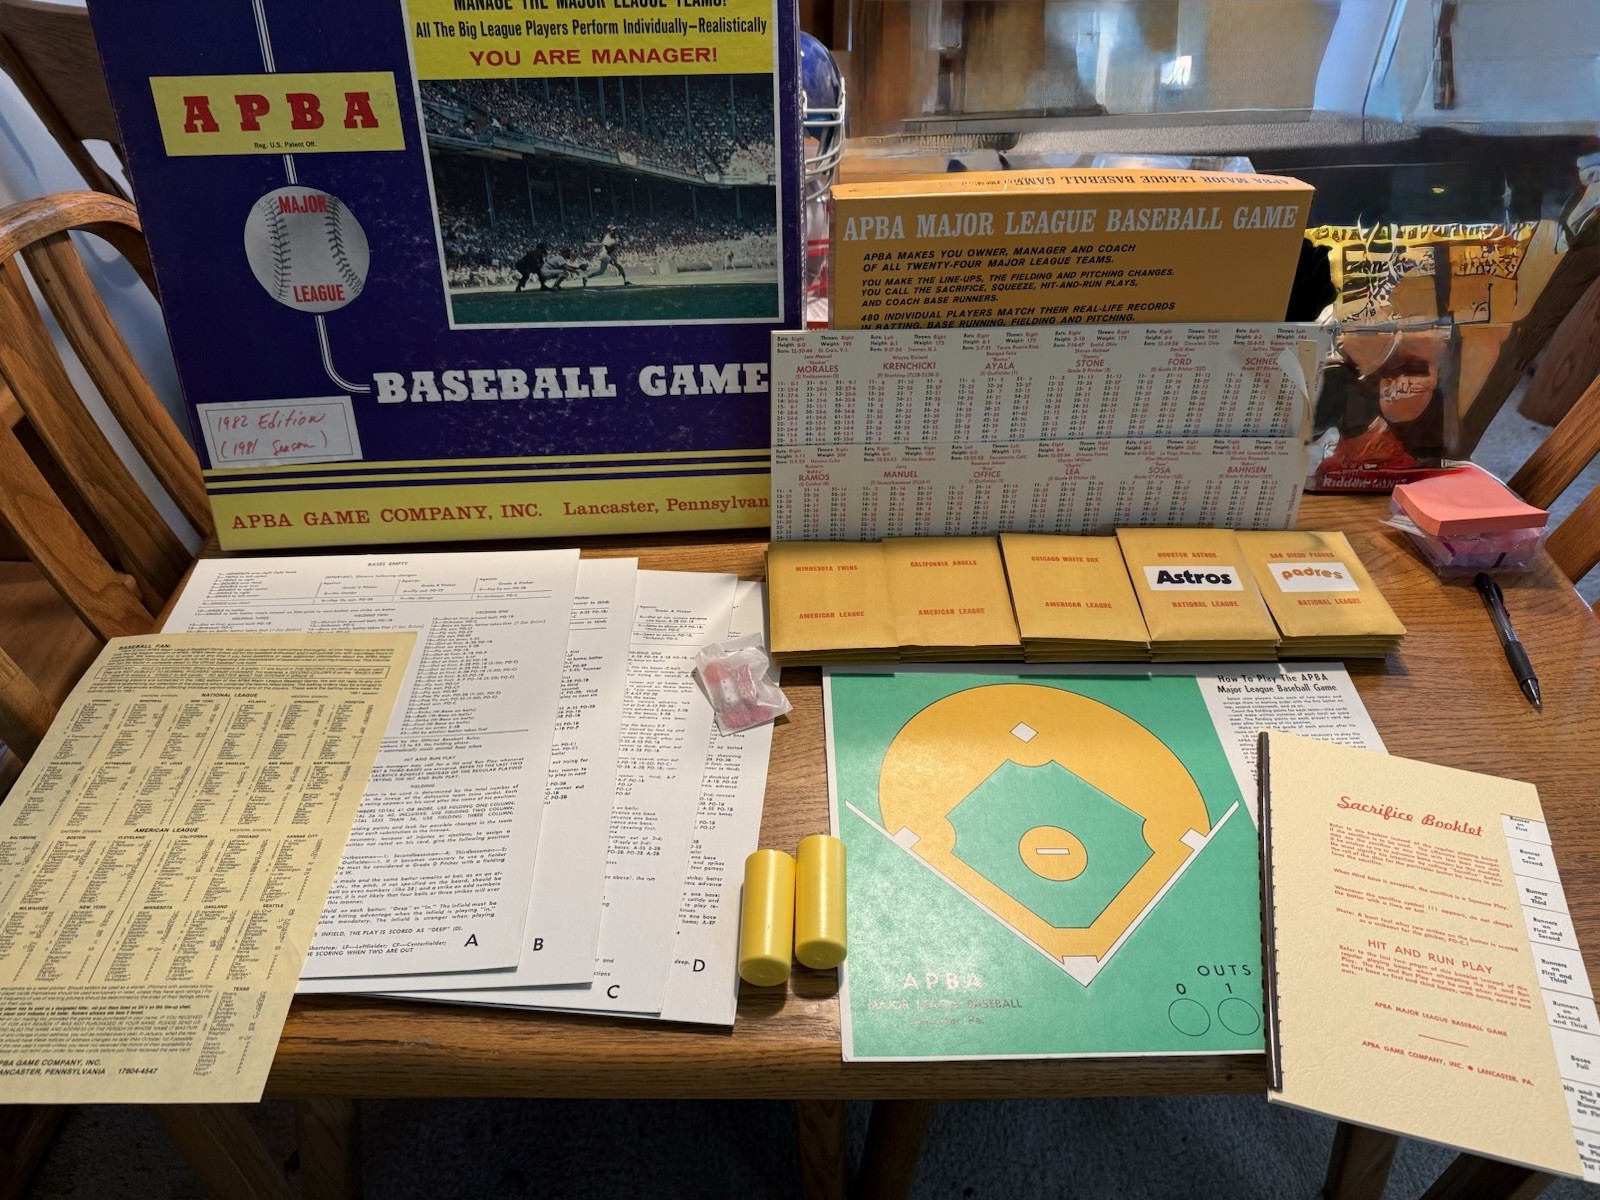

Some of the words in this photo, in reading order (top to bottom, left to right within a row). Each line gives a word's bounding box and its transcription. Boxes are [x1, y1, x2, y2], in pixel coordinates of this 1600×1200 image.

[416, 22, 431, 38] All
[434, 21, 456, 38] The
[458, 20, 478, 40] Big
[480, 20, 522, 39] League
[525, 19, 568, 38] Players
[572, 19, 618, 36] Perform
[469, 50, 520, 66] YOU
[532, 50, 581, 64] ARE
[592, 48, 718, 64] MANAGER!
[183, 92, 379, 133] APBA
[278, 195, 328, 214] MAJOR
[843, 216, 905, 241] APBA
[916, 212, 994, 238] MAJOR
[1004, 209, 1096, 235] LEAGUE
[1106, 207, 1223, 232] BASEBALL
[1233, 205, 1298, 229] GAME
[863, 252, 892, 261] APBA
[898, 250, 935, 259] MAKES
[941, 250, 962, 258] YOU
[967, 248, 1008, 258] OWNER,
[1013, 246, 1066, 255] MANAGER
[1071, 245, 1093, 254] AND
[1098, 244, 1136, 252] COACH
[863, 264, 878, 272] OF
[882, 262, 900, 271] ALL
[907, 260, 982, 270] TWENTY-FOUR
[988, 258, 1025, 268] MAJOR
[1030, 257, 1070, 266] LEAGUE
[1076, 256, 1113, 264] TEAMS.
[862, 278, 881, 287] YOU
[885, 277, 913, 286] MAKE
[918, 277, 935, 285] THE
[939, 275, 984, 284] LINE-UPS,
[1011, 272, 1052, 281] FIELDING
[1080, 270, 1123, 278] PITCHING
[1128, 268, 1174, 276] CHANGES.
[293, 284, 346, 302] LEAGUE
[862, 288, 881, 296] YOU
[885, 287, 909, 295] CALL
[936, 284, 987, 294] SACRIFICE,
[991, 283, 1036, 292] SQUEEZE,
[1040, 281, 1101, 289] HIT-AND-RUN
[1106, 279, 1138, 288] PLAYS,
[862, 299, 881, 307] AND
[953, 295, 998, 303] RUNNERS.
[861, 313, 879, 321] 480
[884, 311, 941, 320] INDIVIDUAL
[947, 309, 992, 318] PLAYERS
[1040, 306, 1068, 314] THEIR
[1073, 304, 1123, 312] REAL-LIFE
[1127, 302, 1176, 311] RECORDS
[797, 365, 838, 373] MORALES
[883, 362, 936, 370] KRENCHICKI
[1076, 359, 1104, 367] STONE
[1168, 358, 1192, 366] FORD
[373, 366, 616, 403] BASEBALL
[638, 363, 768, 396] GAME
[218, 415, 248, 432] 1982
[258, 410, 326, 429] Edition
[232, 514, 293, 530] APBA
[303, 510, 370, 526] GAME
[380, 505, 492, 523] COMPANY,
[501, 504, 542, 518] INC.
[564, 500, 658, 516] Lancaster,
[1157, 570, 1232, 584] Astros
[1281, 566, 1343, 581] padres
[1257, 674, 1276, 683] Play
[1302, 673, 1328, 681] APBA
[1245, 685, 1274, 693] League
[1278, 684, 1310, 692] Baseball
[1337, 796, 1413, 822] Sacrifice
[1421, 814, 1482, 837] Booklet
[464, 934, 478, 946] A
[533, 938, 543, 951] B
[1368, 939, 1387, 950] HIT
[1395, 946, 1421, 958] AND
[1428, 952, 1454, 966] RUN
[1462, 960, 1492, 974] PLAY
[693, 960, 705, 972] D
[1198, 965, 1252, 977] OUTS
[904, 972, 982, 989] APBA
[1176, 983, 1186, 995] 0
[1225, 983, 1232, 994] 1
[607, 985, 620, 998] C
[1362, 1041, 1380, 1049] APBA
[1384, 1046, 1404, 1055] GAME
[1408, 1051, 1445, 1065] COMPANY,
[1449, 1061, 1464, 1069] INC.
[1478, 1068, 1518, 1083] LANCASTER,
